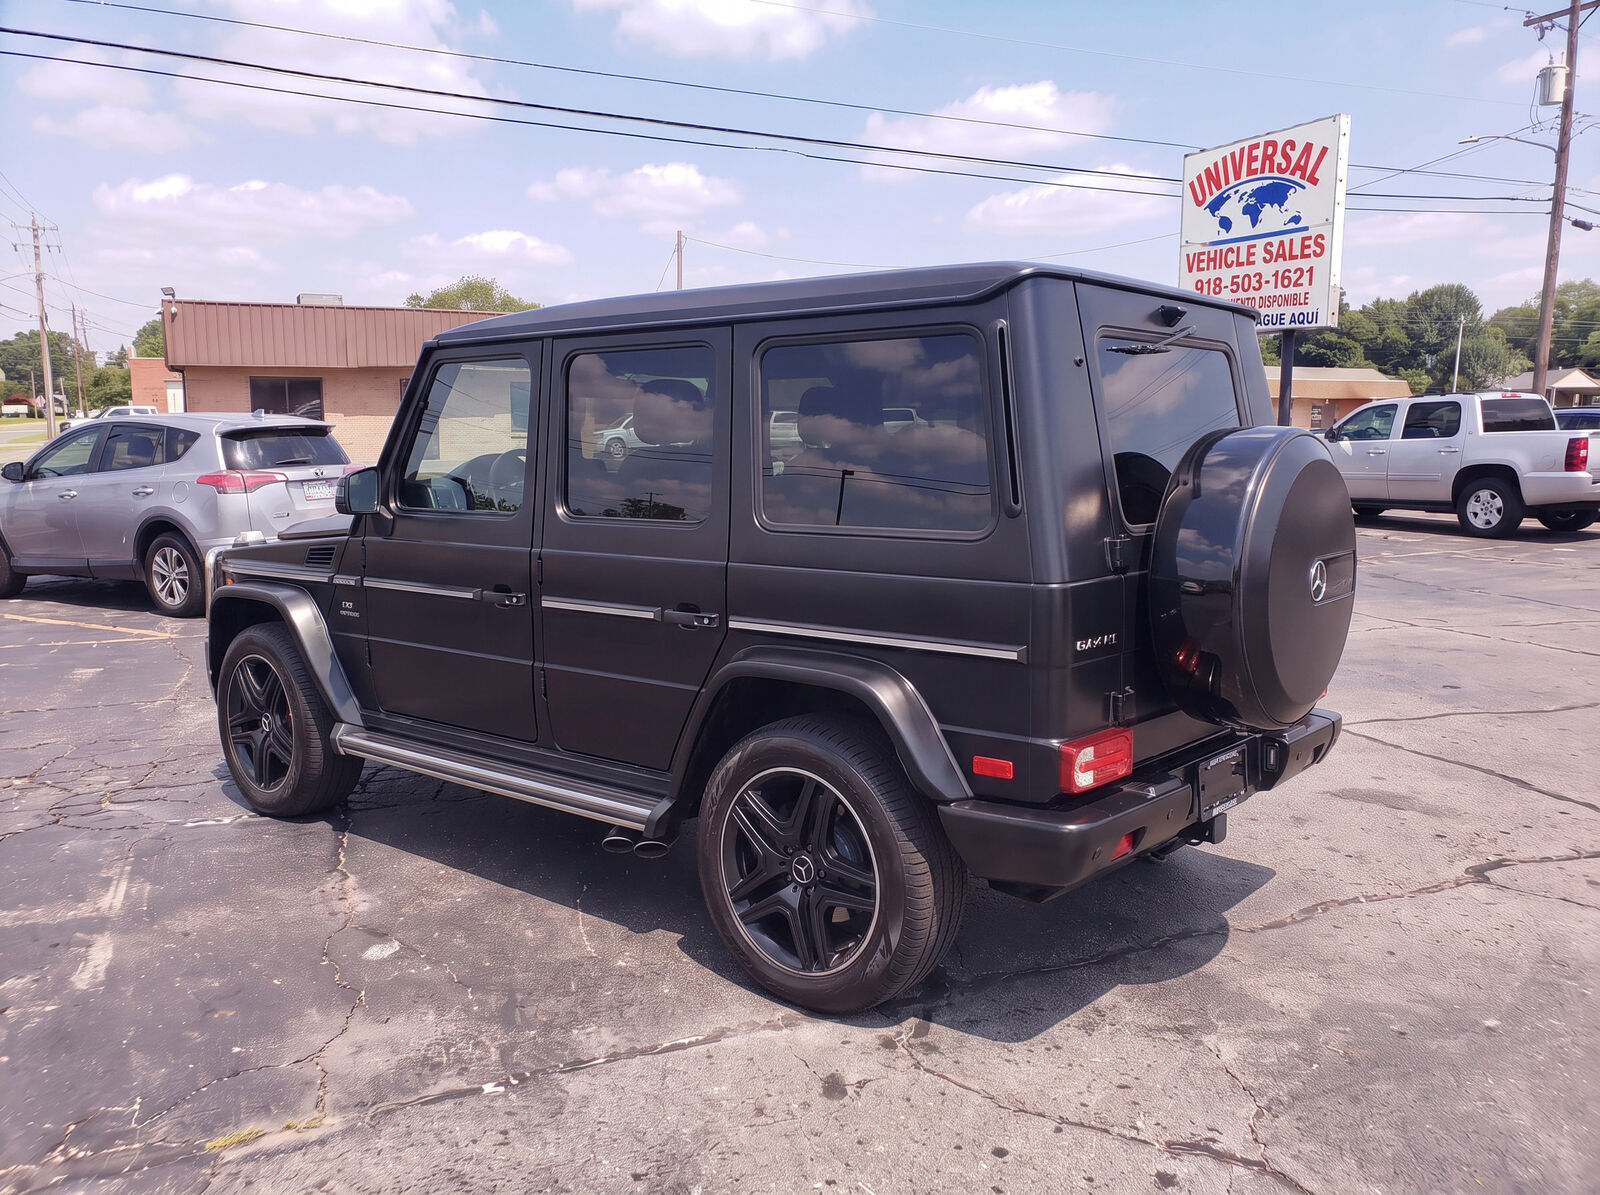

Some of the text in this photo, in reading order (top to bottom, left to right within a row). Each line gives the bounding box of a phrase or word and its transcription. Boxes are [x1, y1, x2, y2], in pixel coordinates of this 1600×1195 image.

[1189, 139, 1329, 208] UNIVERSAL
[1186, 233, 1326, 274] VEHICLE SALES
[1195, 266, 1315, 296] 918-503-1621
[1258, 292, 1310, 309] DISPONIBLE
[1289, 307, 1320, 326] AQUÍ
